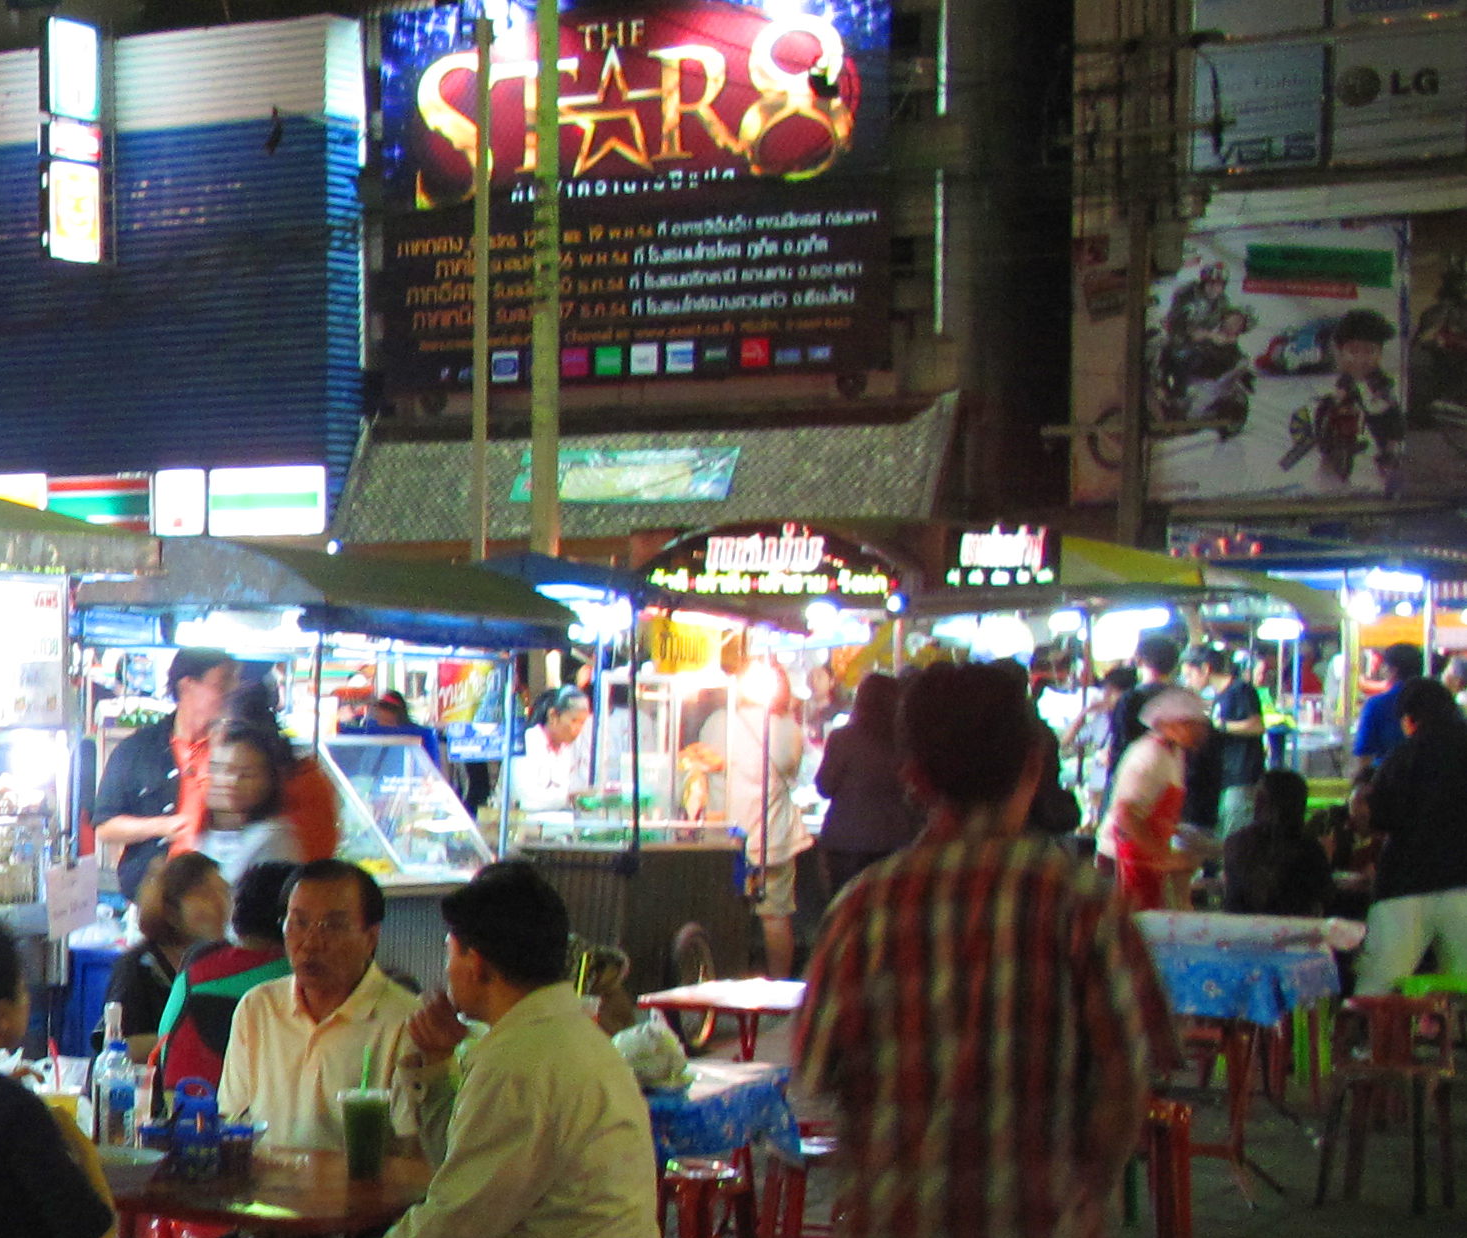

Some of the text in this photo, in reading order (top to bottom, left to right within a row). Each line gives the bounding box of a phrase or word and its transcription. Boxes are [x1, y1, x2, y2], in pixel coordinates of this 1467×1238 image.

[579, 19, 645, 50] THE
[740, 13, 862, 181] 8
[1390, 68, 1439, 96] LG
